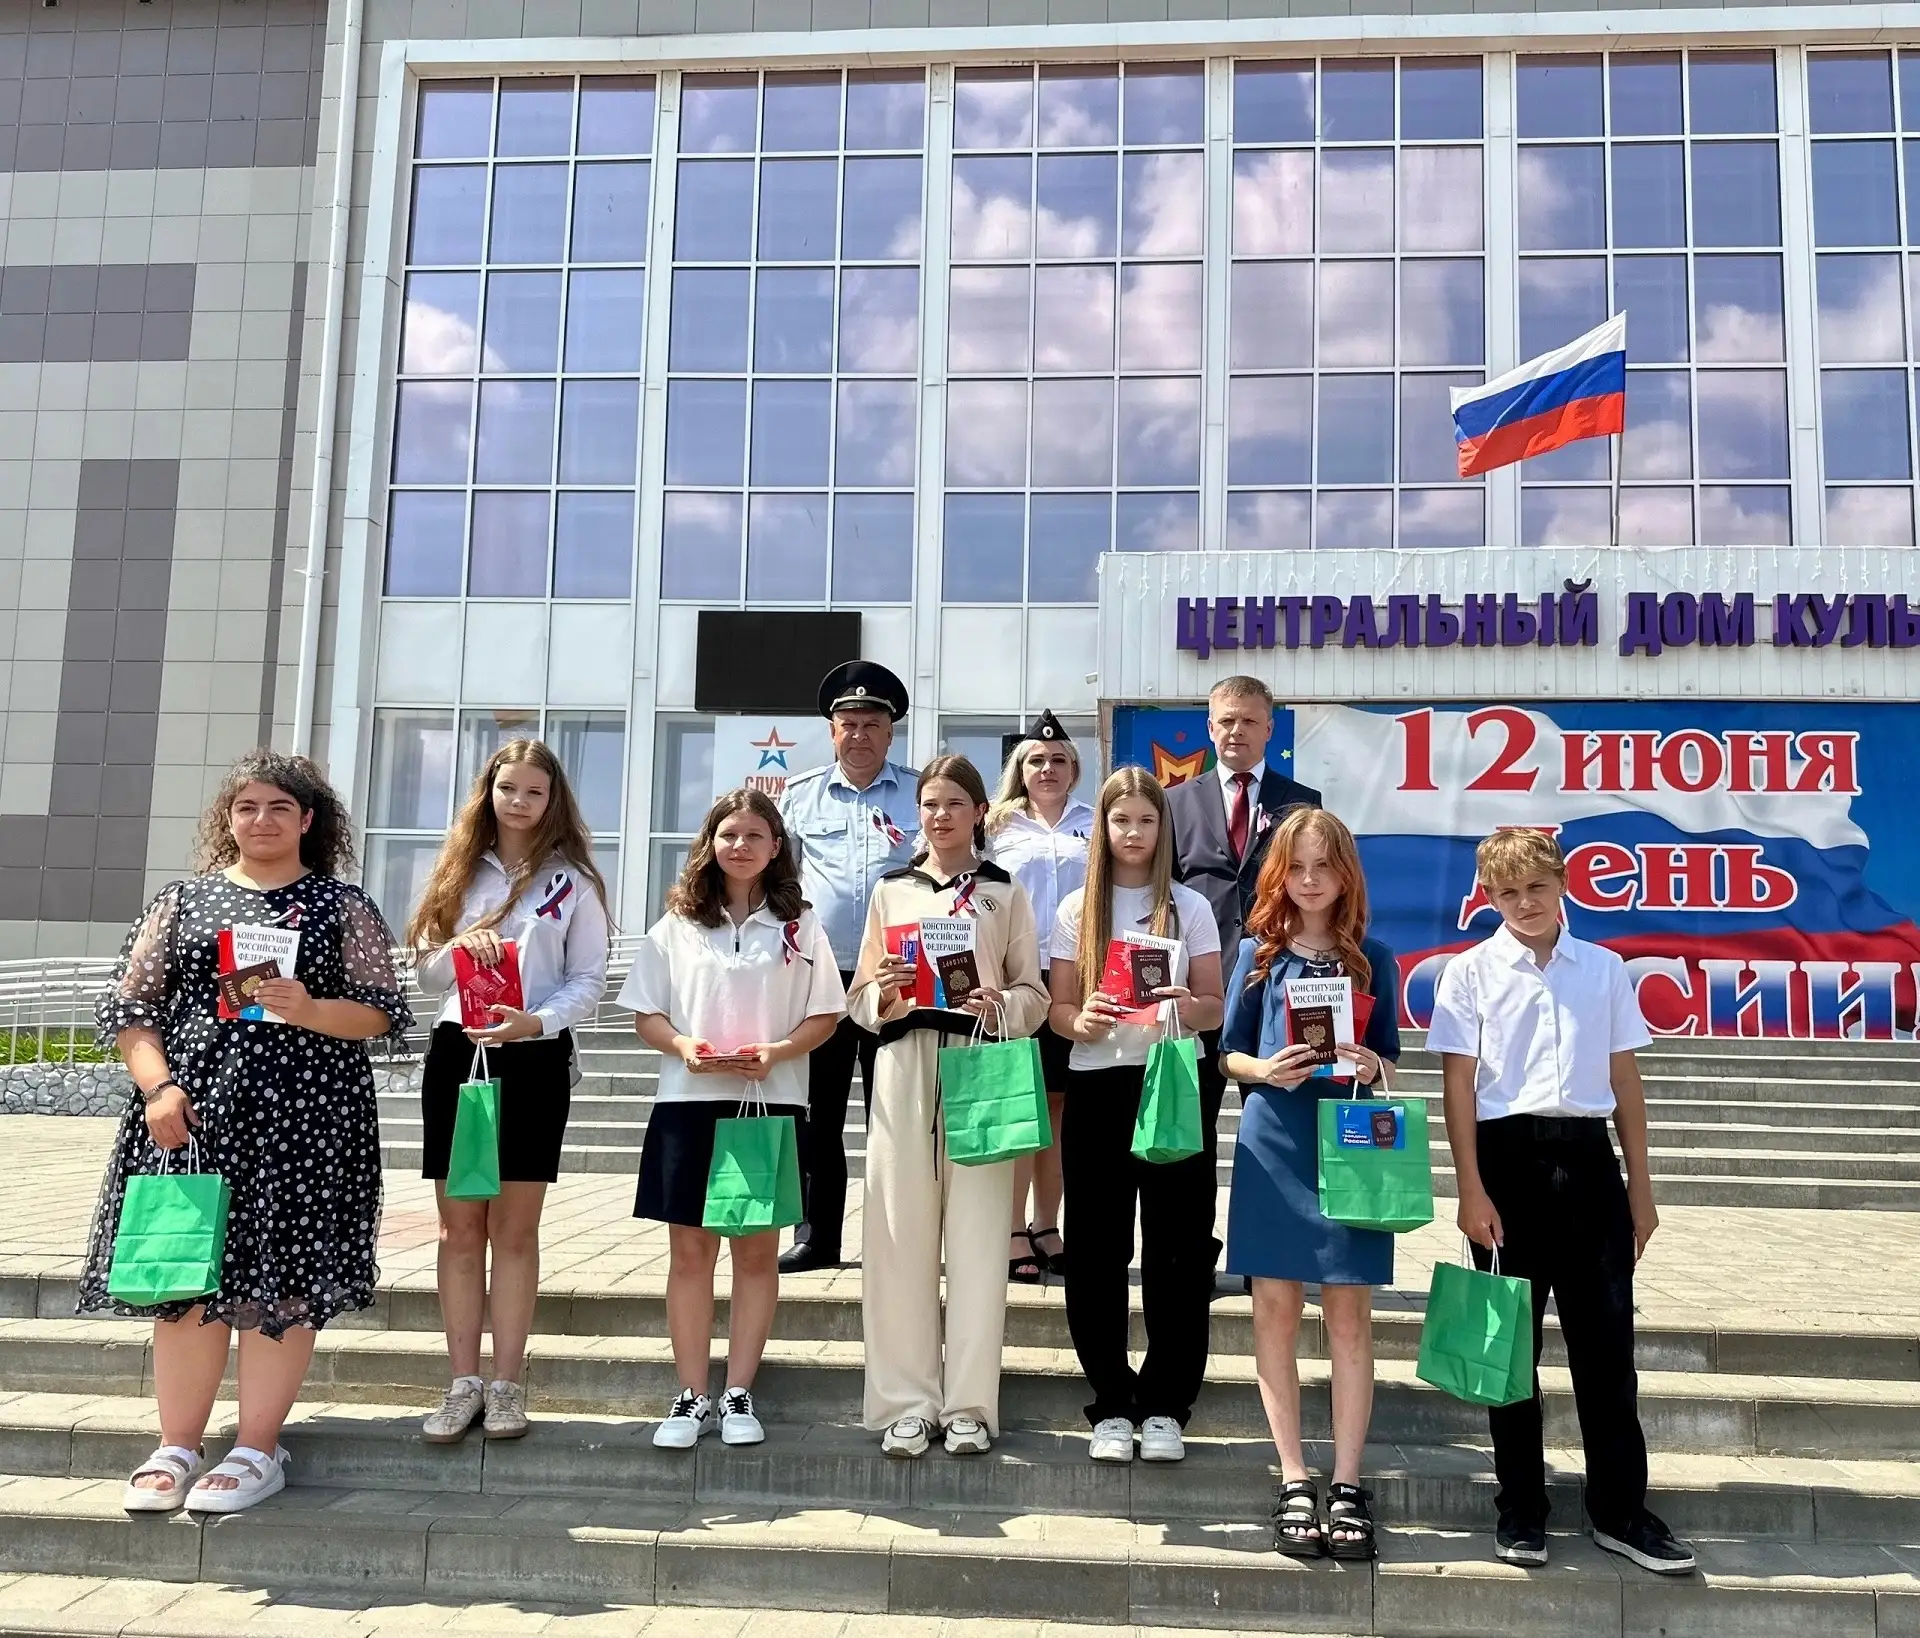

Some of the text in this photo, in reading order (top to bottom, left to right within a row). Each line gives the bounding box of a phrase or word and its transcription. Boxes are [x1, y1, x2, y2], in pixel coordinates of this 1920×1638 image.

[1176, 578, 1920, 660] ЦЕНТРАЛЬНЫЙ ДОМ КУЛЬ
[1393, 705, 1541, 796] 12
[745, 776, 787, 795] СЛУЖ
[922, 922, 971, 931] КОНСТИТУЦИЯ
[236, 931, 293, 945] КОНСТИТУЦИЯ
[924, 932, 969, 942] РОССИЙСКОЙ
[237, 941, 289, 954] РОССИЙСКОЙ
[926, 943, 966, 952] ФЕДЕРАЦИИ
[1290, 983, 1345, 993] КОНСТИТУЦИЯ
[1293, 993, 1344, 1004] РОССИЙСКОЙ
